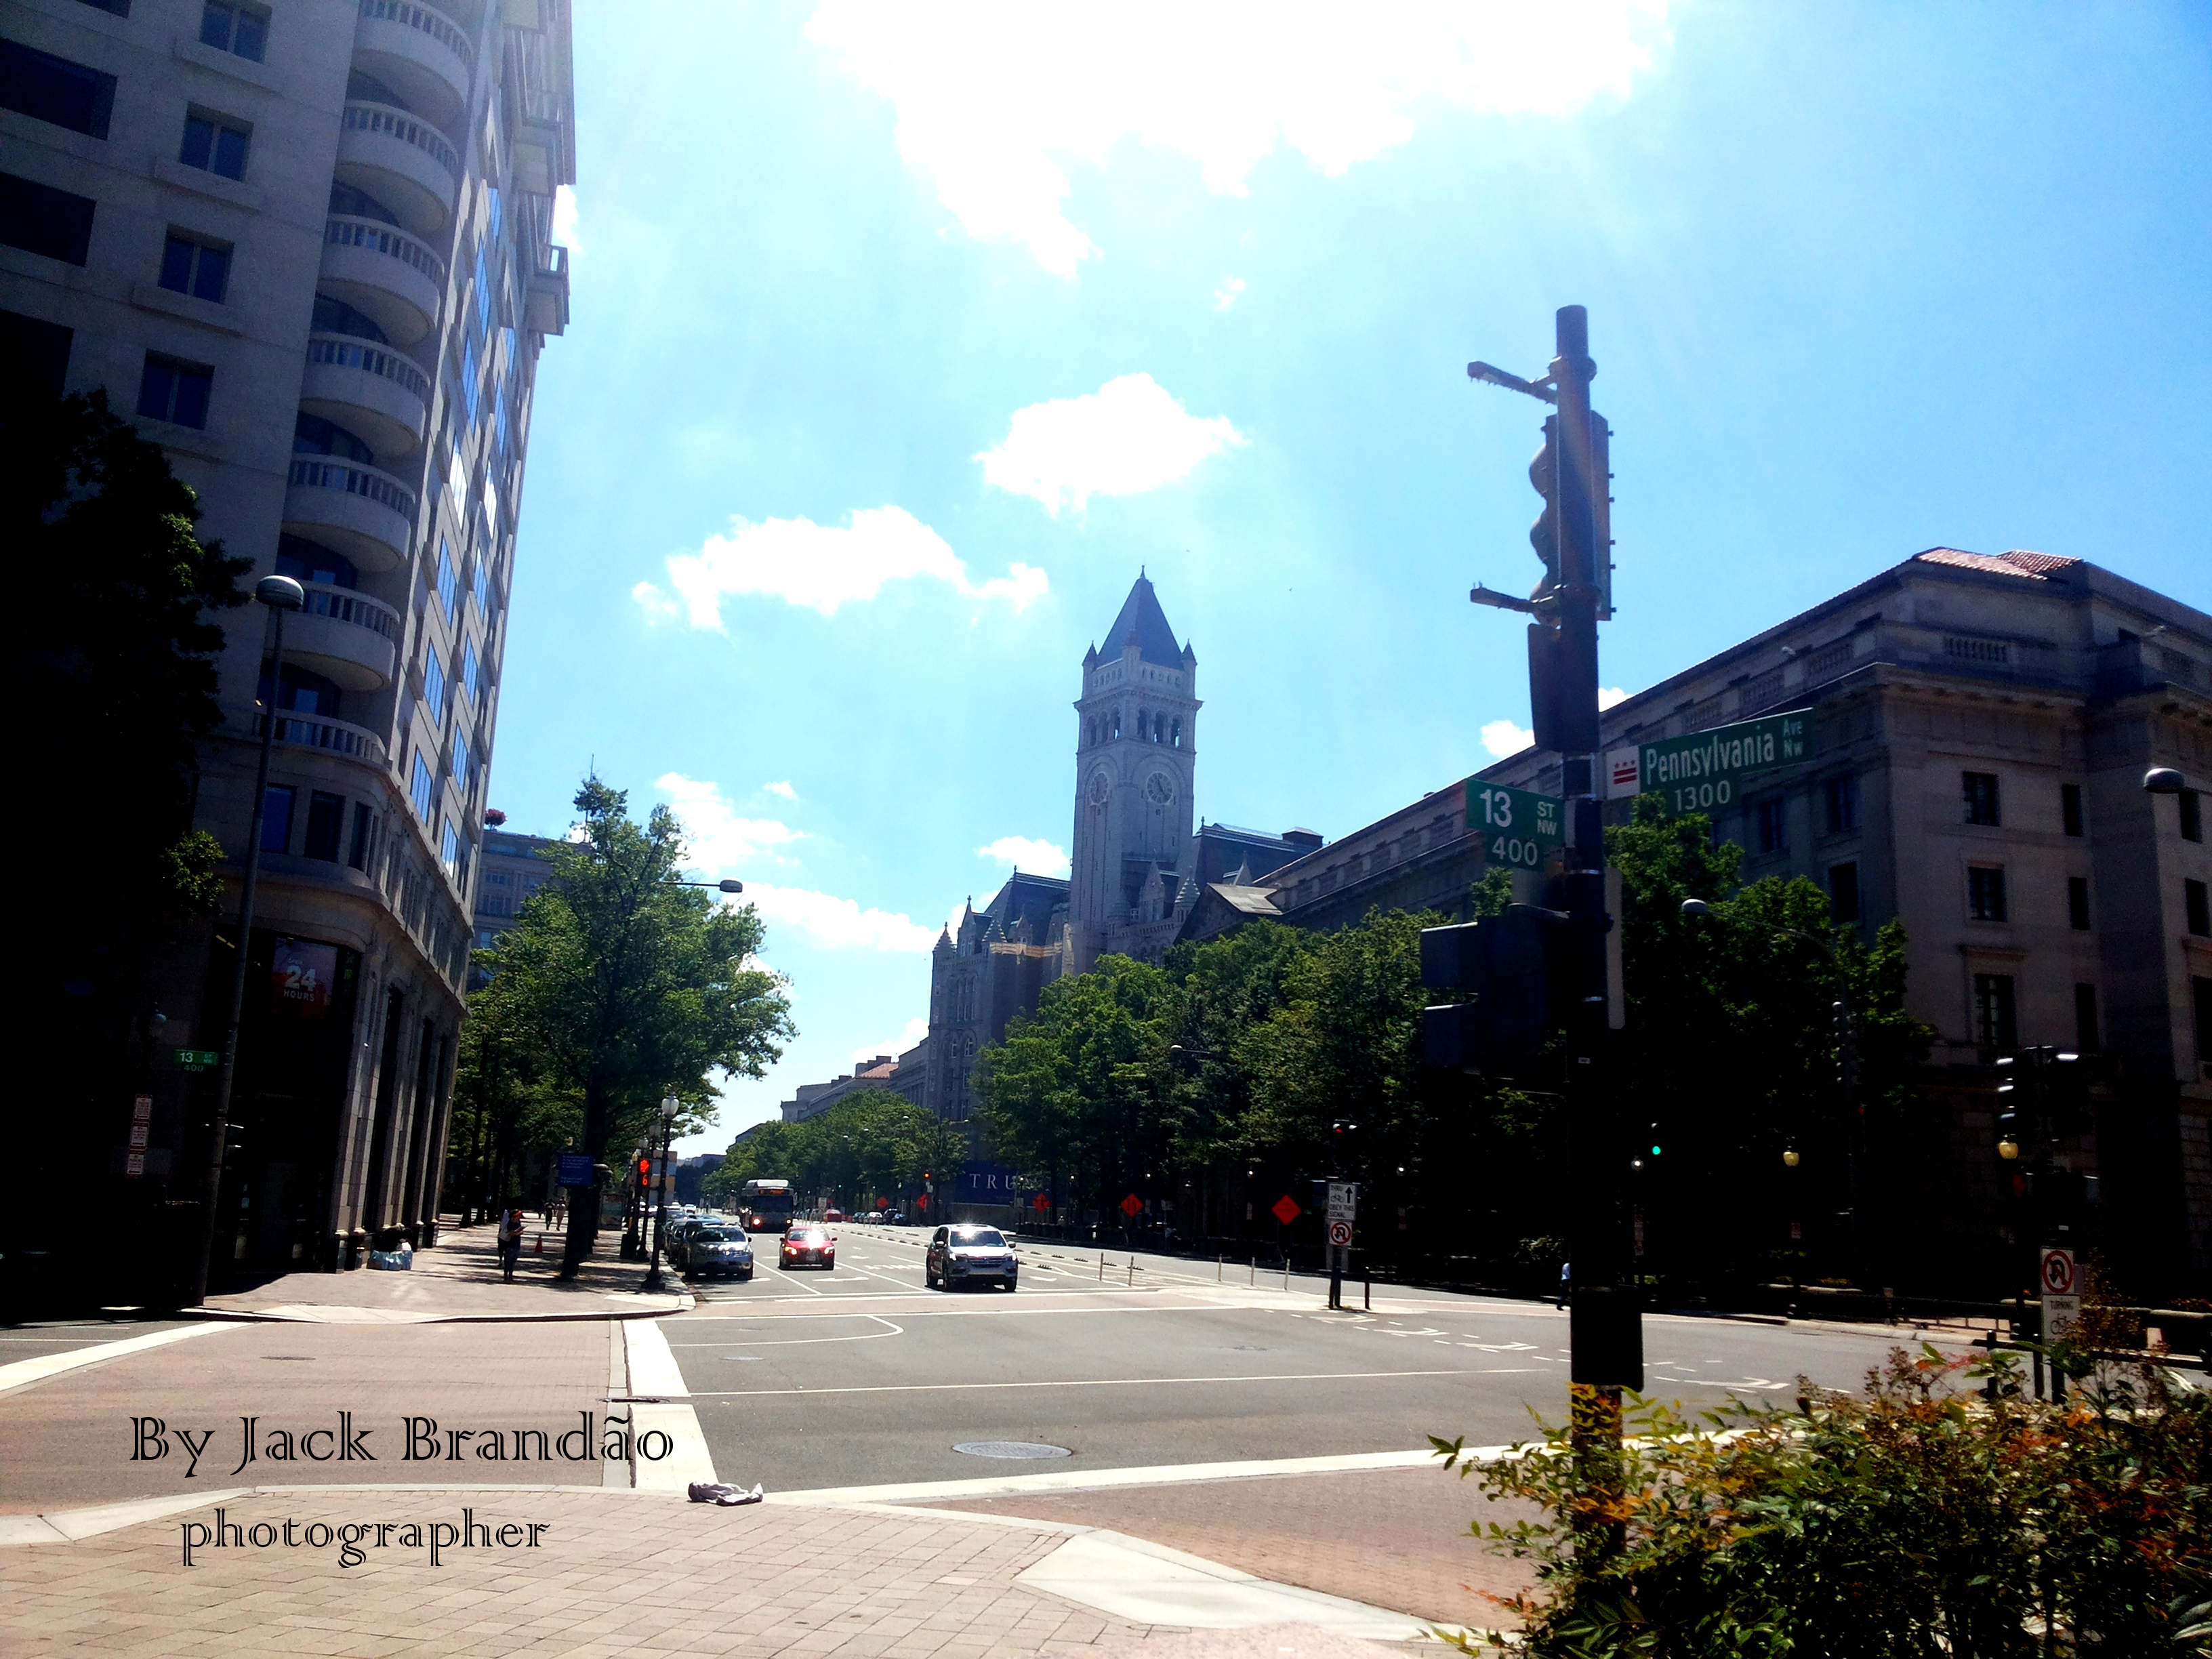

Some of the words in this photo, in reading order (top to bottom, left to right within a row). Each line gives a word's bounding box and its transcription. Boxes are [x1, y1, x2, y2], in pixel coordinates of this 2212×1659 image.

[1646, 729, 1775, 785] Pennsylvania
[1783, 718, 1803, 737] Ave
[1479, 788, 1513, 828] 13
[1536, 802, 1555, 819] ST
[1675, 781, 1731, 813] 1300
[1536, 818, 1557, 836] NW
[1492, 836, 1538, 867] 400
[284, 965, 317, 992] 24
[283, 988, 316, 1002] HOURS
[180, 1052, 193, 1063] 13
[184, 1064, 204, 1072] 400
